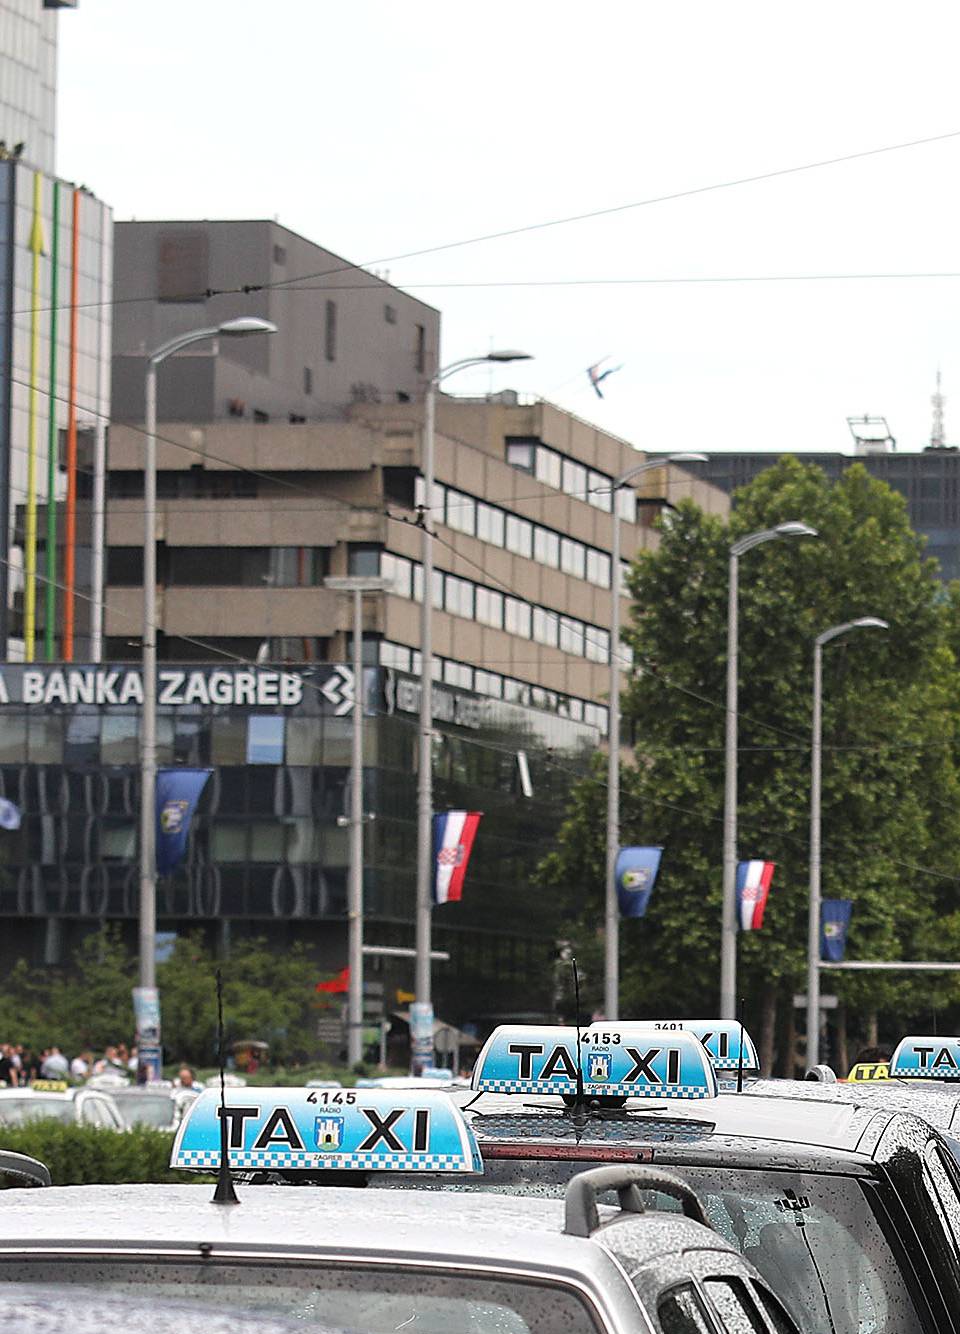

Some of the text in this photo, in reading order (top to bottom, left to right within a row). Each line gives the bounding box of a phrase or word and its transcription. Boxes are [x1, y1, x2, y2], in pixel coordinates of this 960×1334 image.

[23, 671, 145, 705] BANKA
[159, 672, 302, 705] ZAGREB
[581, 1032, 621, 1045] 4153
[306, 1091, 357, 1105] 4145
